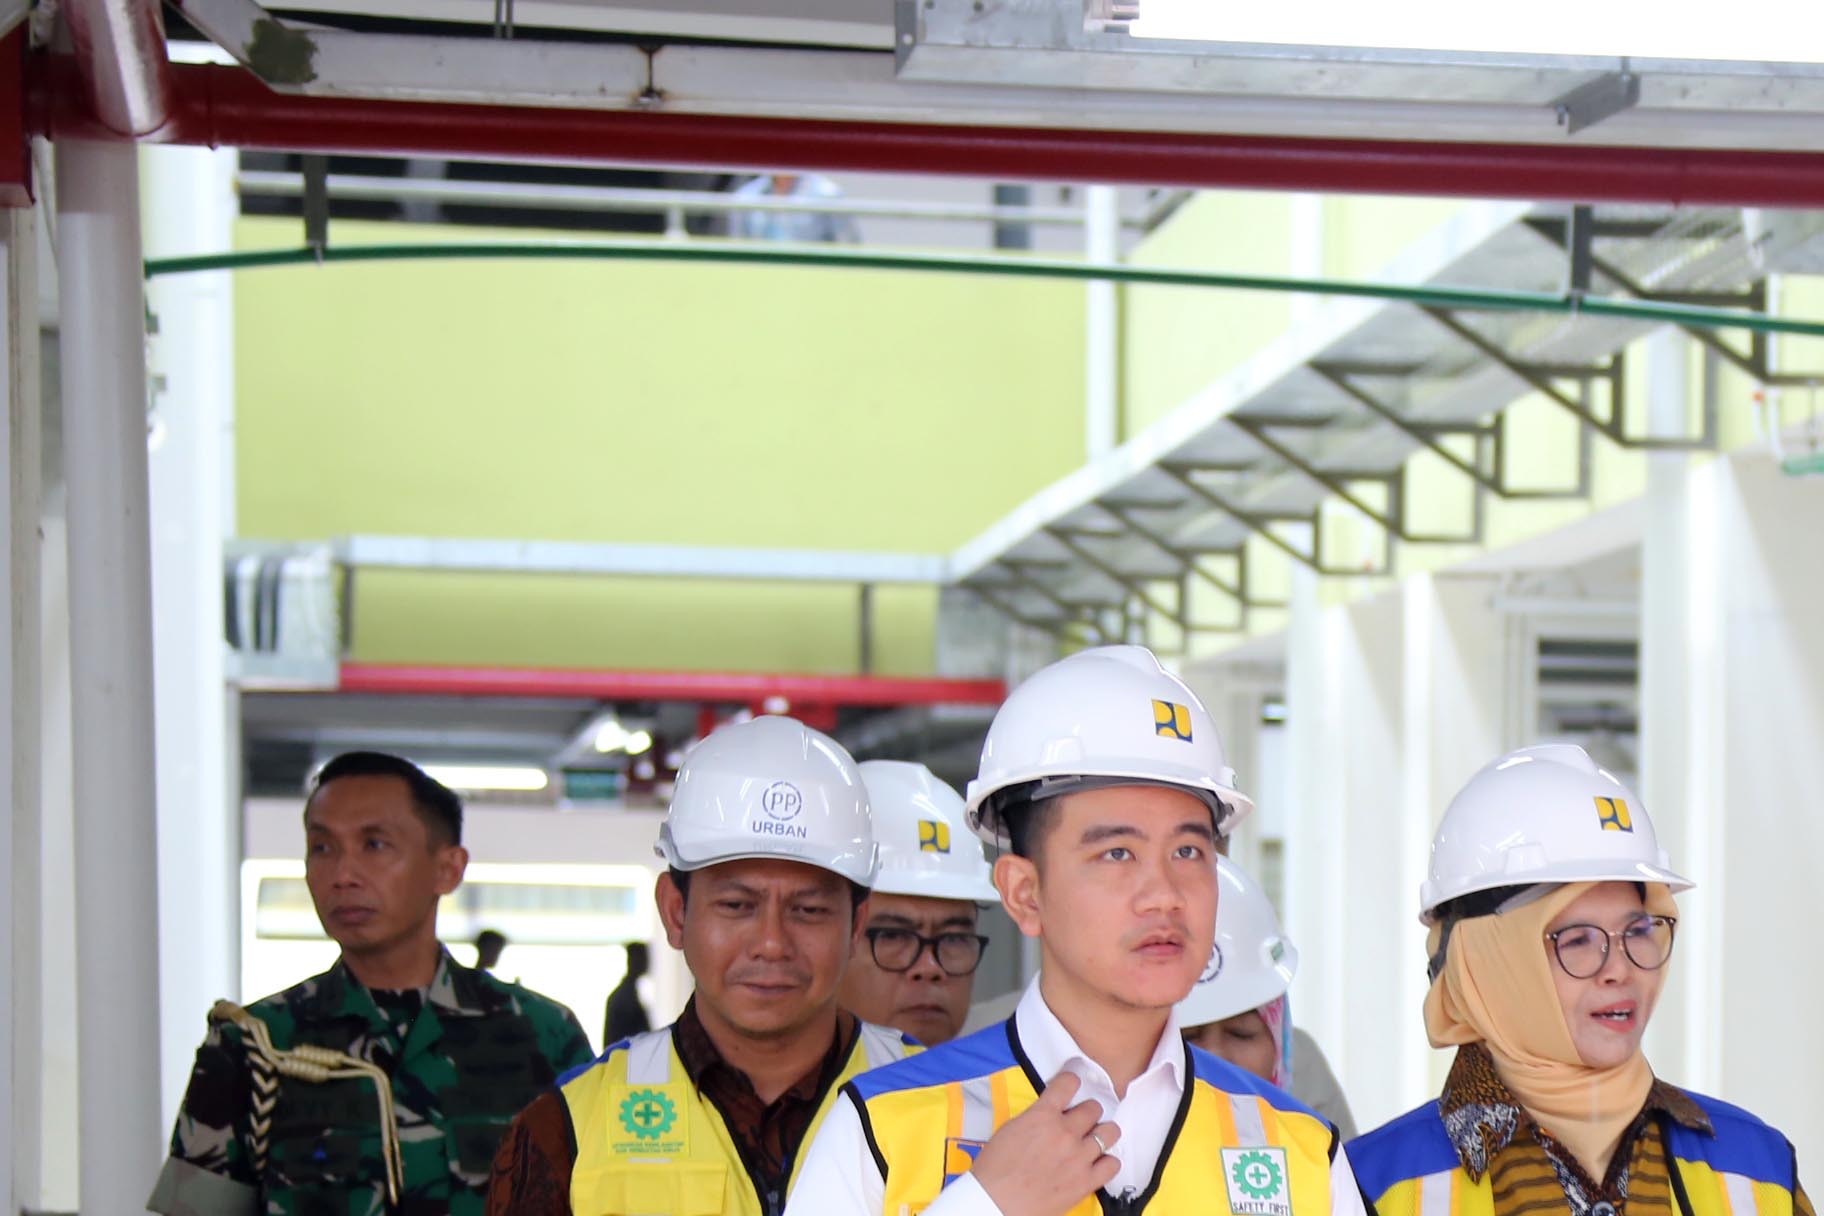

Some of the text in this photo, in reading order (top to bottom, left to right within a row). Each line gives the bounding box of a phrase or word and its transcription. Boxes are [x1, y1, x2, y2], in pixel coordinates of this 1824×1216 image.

[771, 792, 796, 812] PP
[752, 821, 807, 838] URBAN
[1233, 1202, 1288, 1216] SAFETY FIRST
